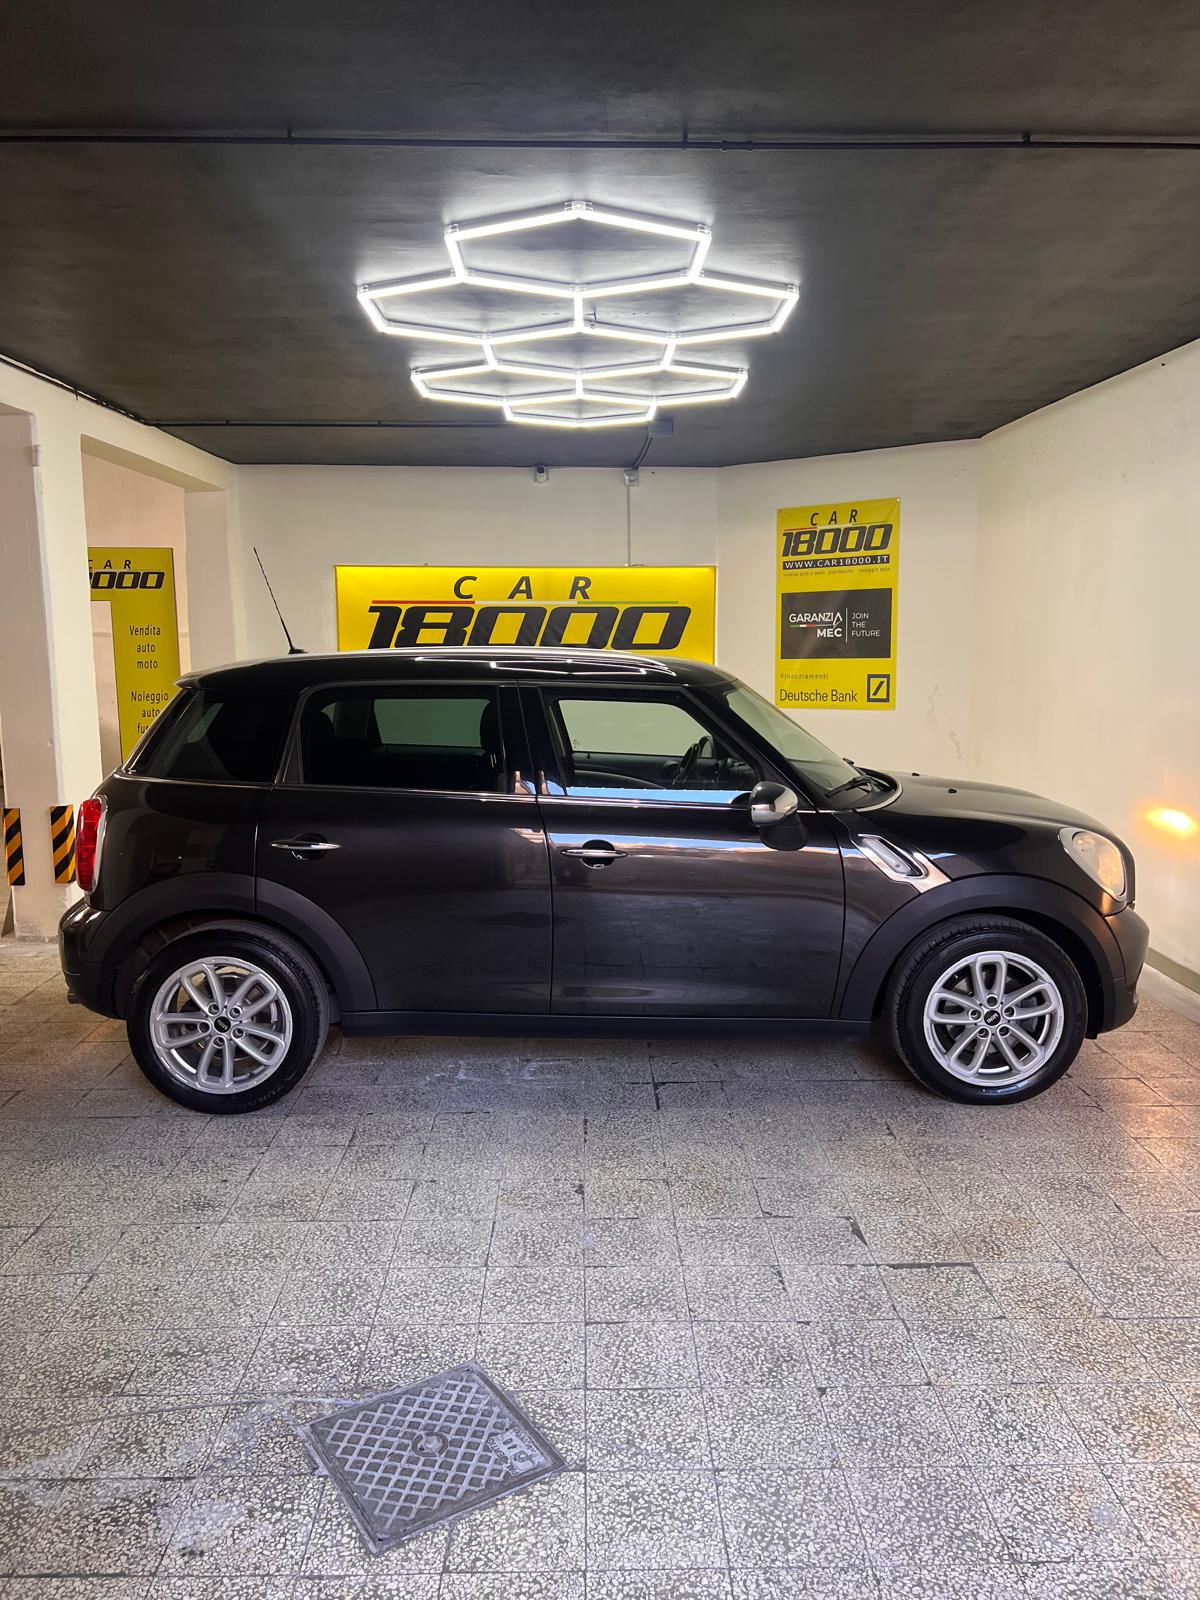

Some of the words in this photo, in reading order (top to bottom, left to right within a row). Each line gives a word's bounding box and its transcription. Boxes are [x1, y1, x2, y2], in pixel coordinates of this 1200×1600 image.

[810, 508, 858, 527] CAR
[782, 524, 893, 557] 18000
[785, 555, 889, 569] WWW.CAR18000.IT
[89, 571, 165, 590] 000
[453, 575, 592, 600] CAR
[788, 611, 843, 626] GARANZIA
[851, 612, 869, 620] JOIN
[129, 624, 161, 636] Vendita
[367, 605, 692, 651] 18000
[852, 621, 866, 629] THE
[816, 628, 843, 638] MEC
[851, 629, 881, 637] FUTURE
[136, 643, 156, 653] auto
[136, 660, 158, 669] moto
[130, 691, 169, 705] Noleggio
[779, 688, 828, 702] Deutsche
[831, 689, 858, 703] Bank
[141, 708, 161, 718] auto
